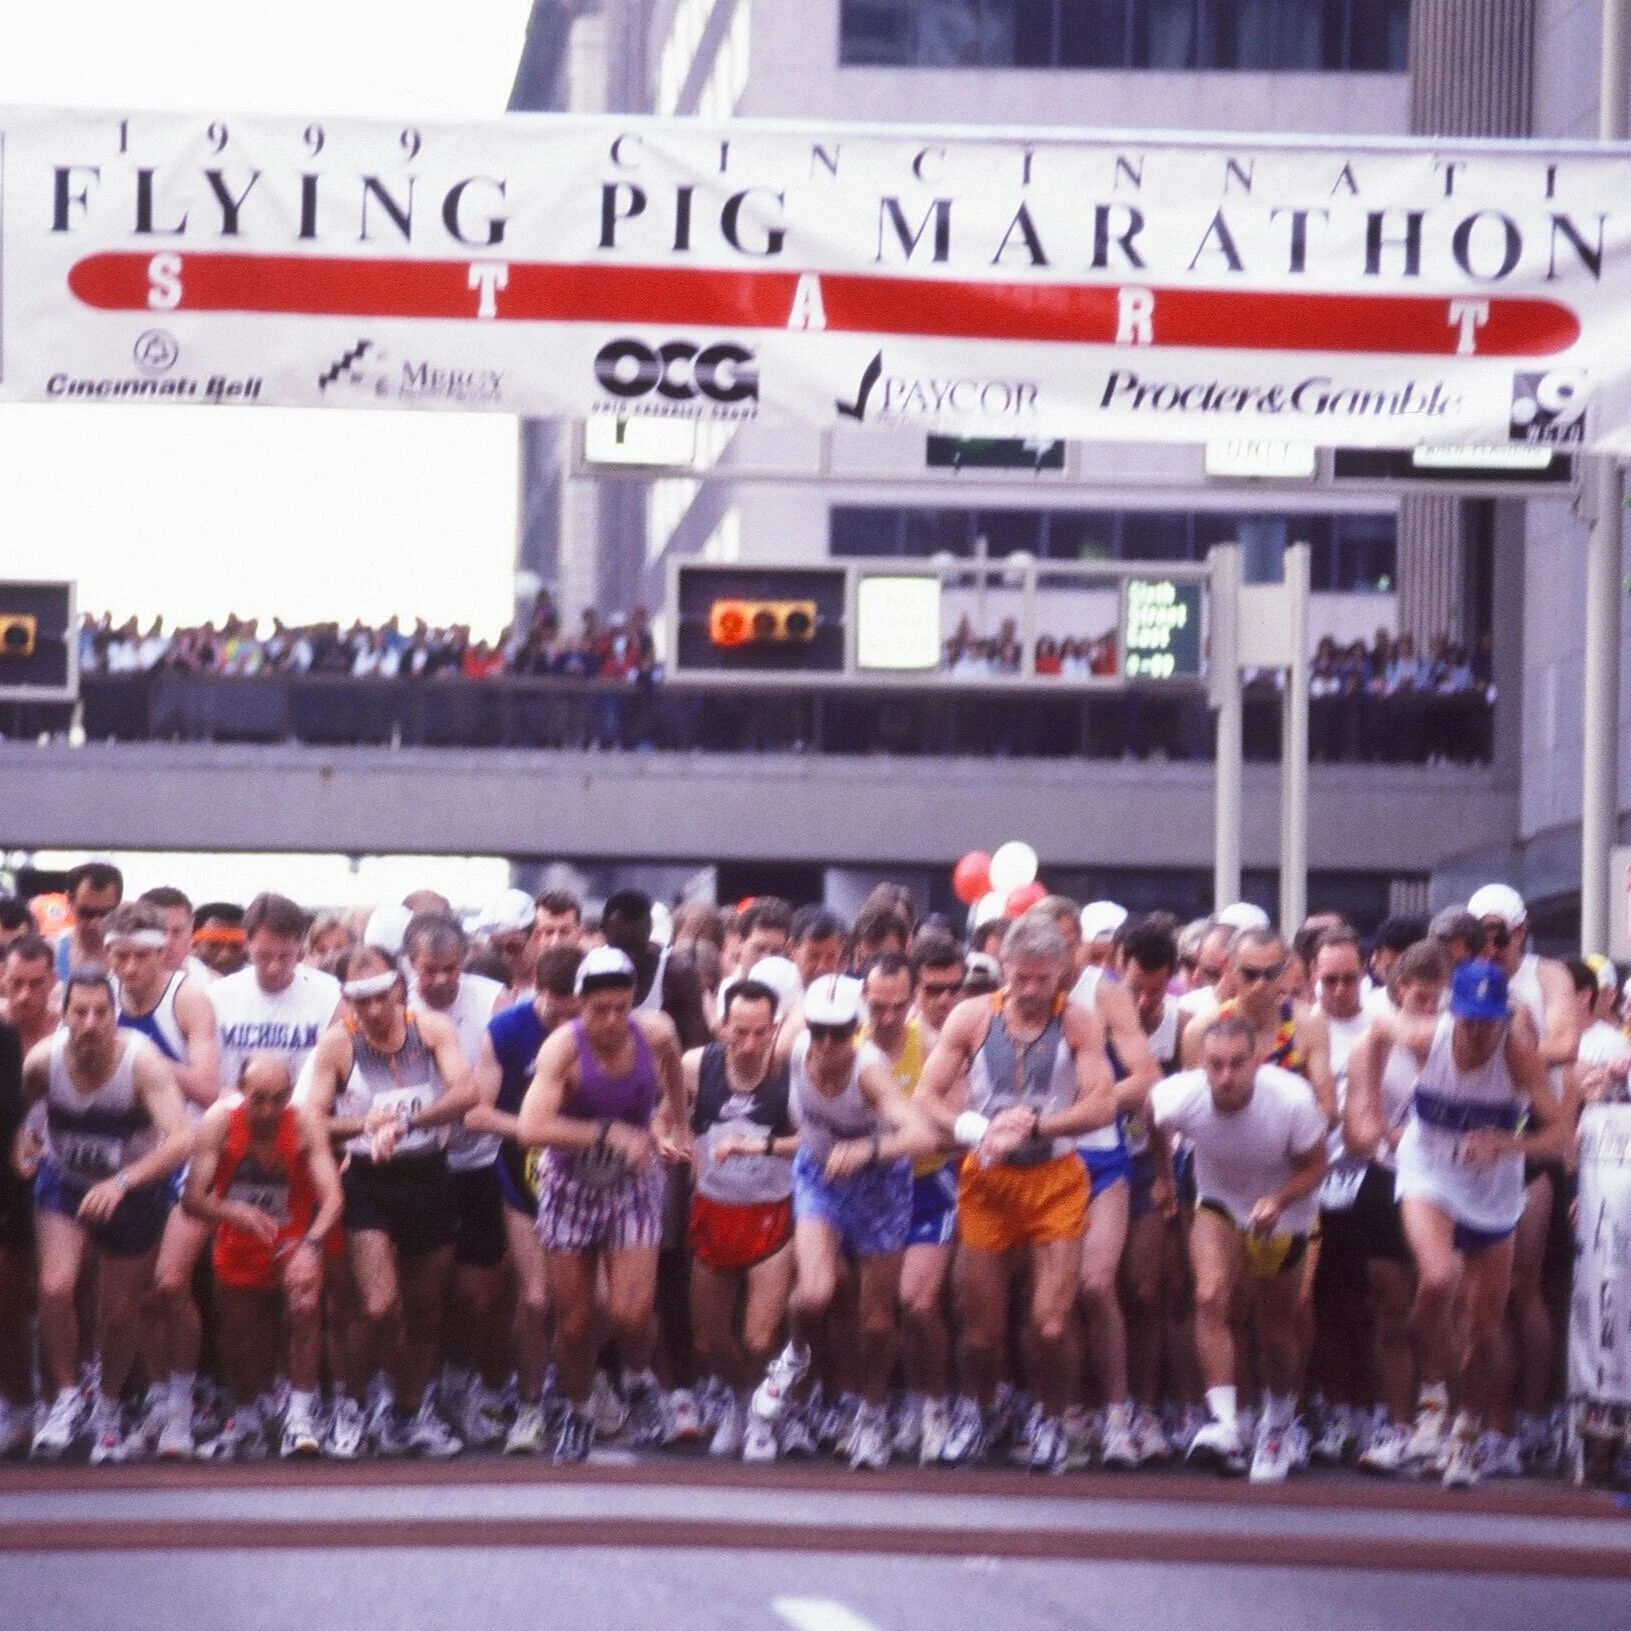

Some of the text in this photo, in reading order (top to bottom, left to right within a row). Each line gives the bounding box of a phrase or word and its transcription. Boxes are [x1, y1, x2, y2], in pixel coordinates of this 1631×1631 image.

[117, 119, 1558, 201] 1999 CINCINNATI
[49, 165, 1606, 285] FLYING PIG MARATHON
[146, 254, 1491, 356] START
[46, 372, 263, 400] Cincinnati Bell
[876, 378, 1040, 416] PAYCOR
[220, 1021, 320, 1051] MICHIGAN
